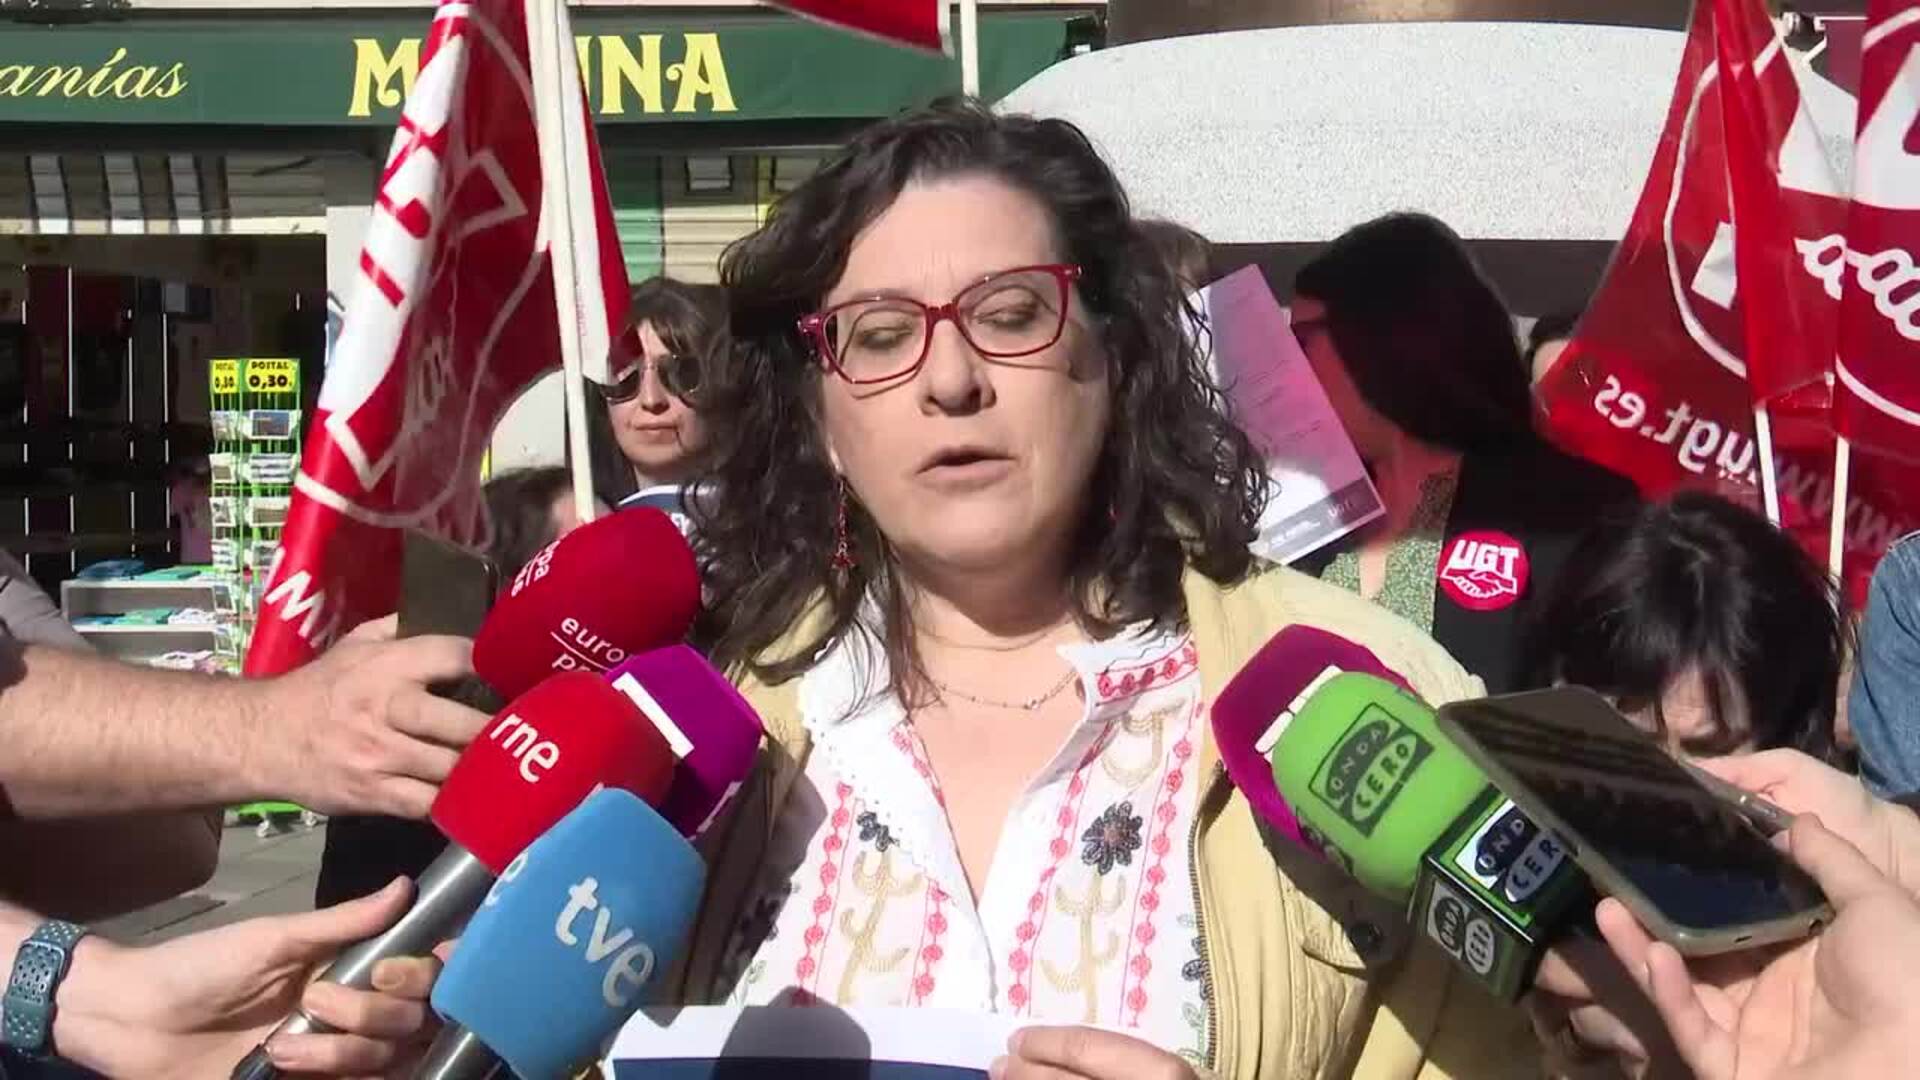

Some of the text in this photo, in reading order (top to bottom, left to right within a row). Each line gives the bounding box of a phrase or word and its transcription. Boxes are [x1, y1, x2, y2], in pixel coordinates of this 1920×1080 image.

[1447, 539, 1519, 581] UGT
[561, 617, 624, 662] euro
[489, 713, 560, 783] rne
[1330, 728, 1383, 791] ONDA
[1355, 743, 1409, 809] CERO
[1478, 818, 1526, 868] OND
[1511, 839, 1562, 890] CER
[555, 876, 655, 1008] tve
